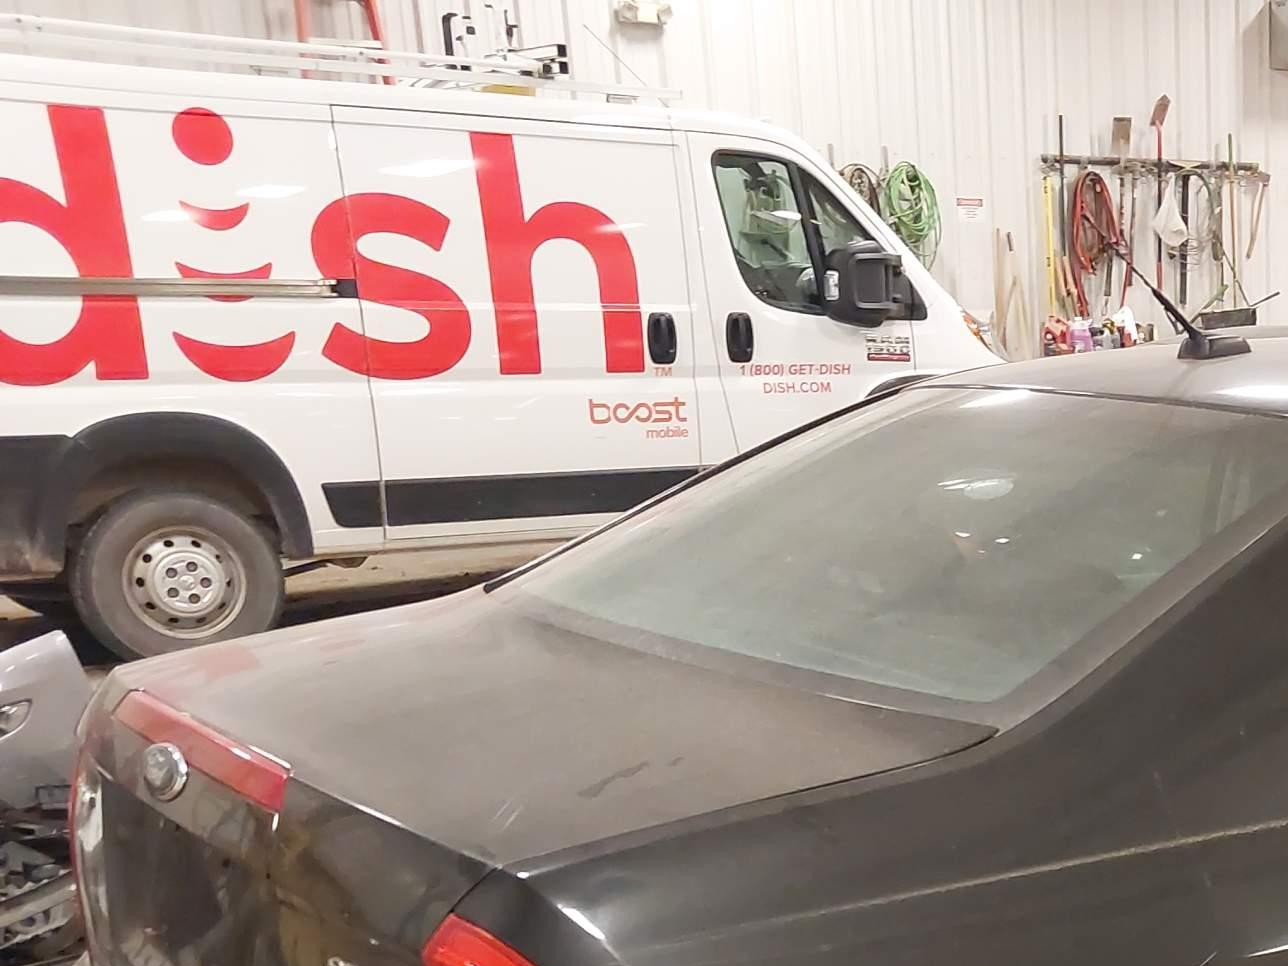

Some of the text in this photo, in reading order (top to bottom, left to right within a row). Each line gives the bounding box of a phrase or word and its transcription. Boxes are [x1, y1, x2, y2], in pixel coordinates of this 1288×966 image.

[0, 104, 645, 386] dish
[653, 367, 673, 377] TM
[739, 363, 851, 376] 1 (800) GET-DISH
[763, 381, 832, 394] DISH.COM
[588, 397, 687, 424] boost
[646, 426, 688, 438] mobile
